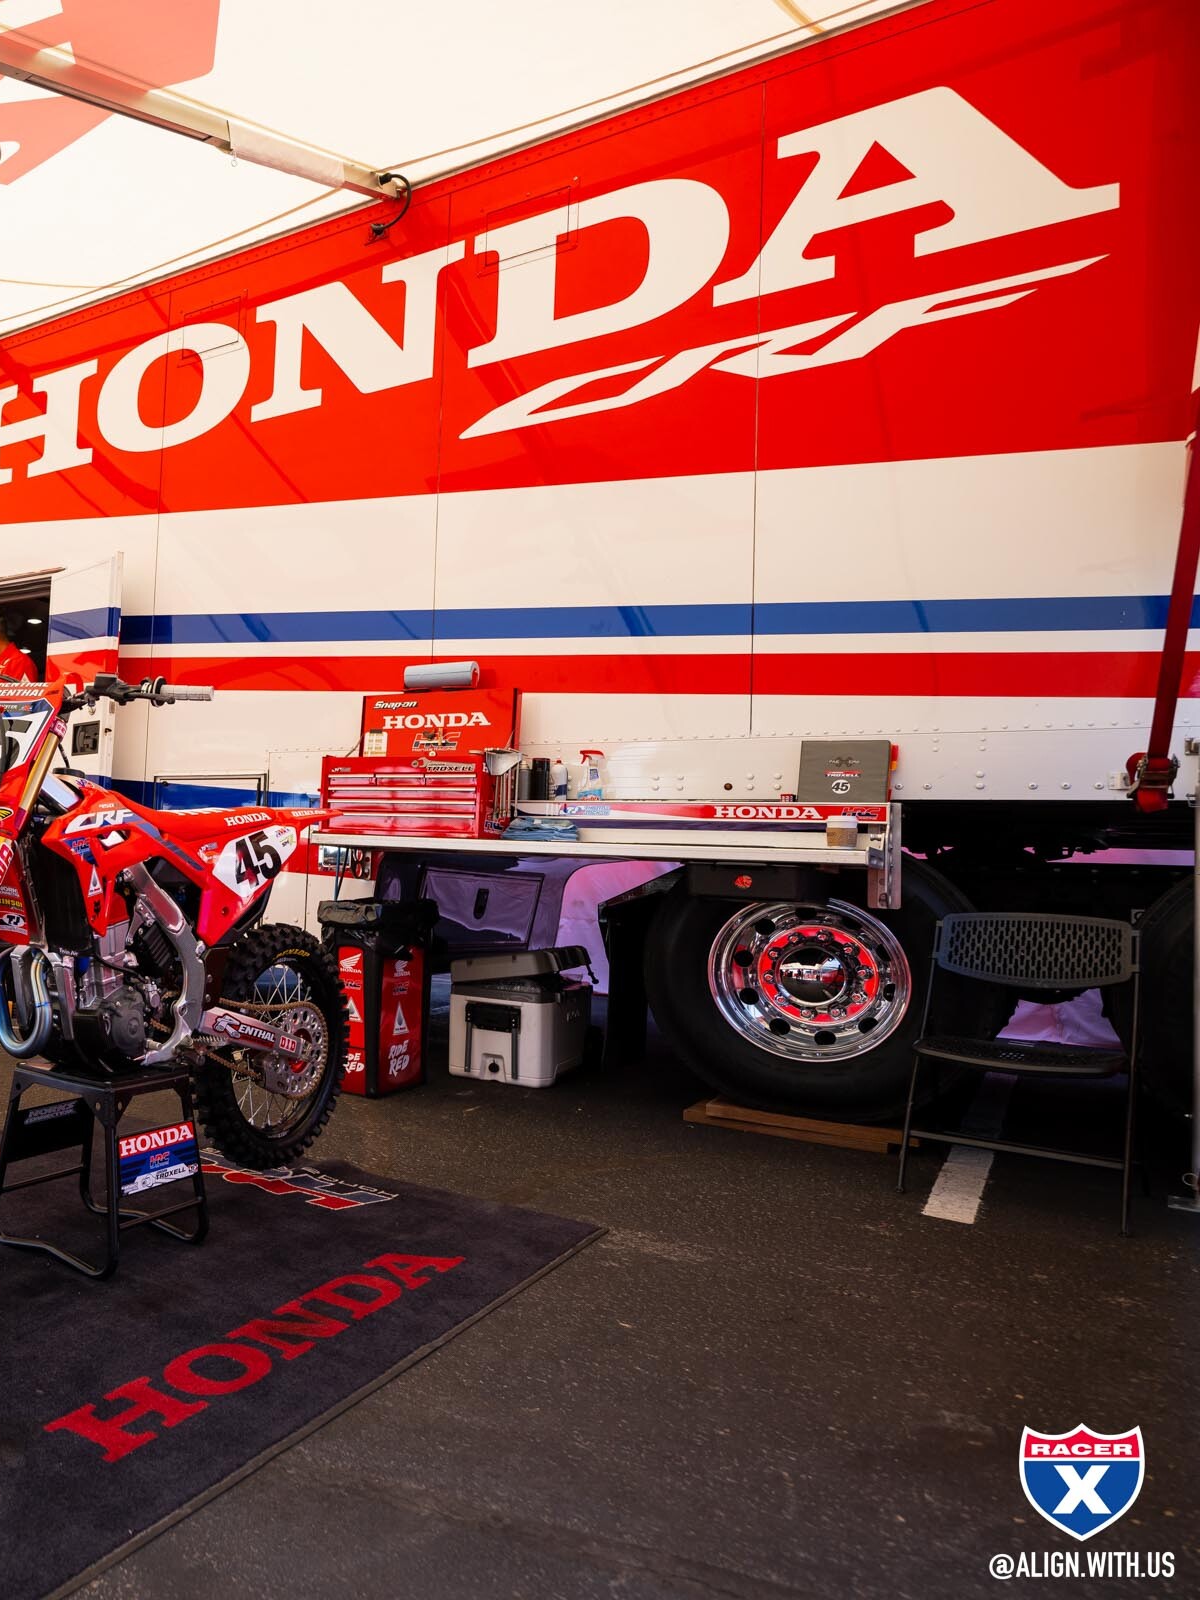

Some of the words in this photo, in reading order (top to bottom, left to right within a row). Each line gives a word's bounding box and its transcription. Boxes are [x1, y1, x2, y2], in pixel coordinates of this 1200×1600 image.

[460, 254, 1111, 440] CRF
[373, 701, 418, 710] Snap-on
[382, 712, 492, 730] HONDA
[831, 781, 851, 793] 45
[64, 808, 135, 834] CRF
[224, 811, 272, 827] HONDA
[714, 806, 824, 819] HONDA
[235, 830, 283, 887] 45
[388, 1039, 409, 1060] RIDE
[388, 1054, 410, 1077] RED
[119, 1124, 194, 1157] HONDA
[155, 1166, 187, 1181] TROXELL
[43, 1253, 466, 1463] HONDA
